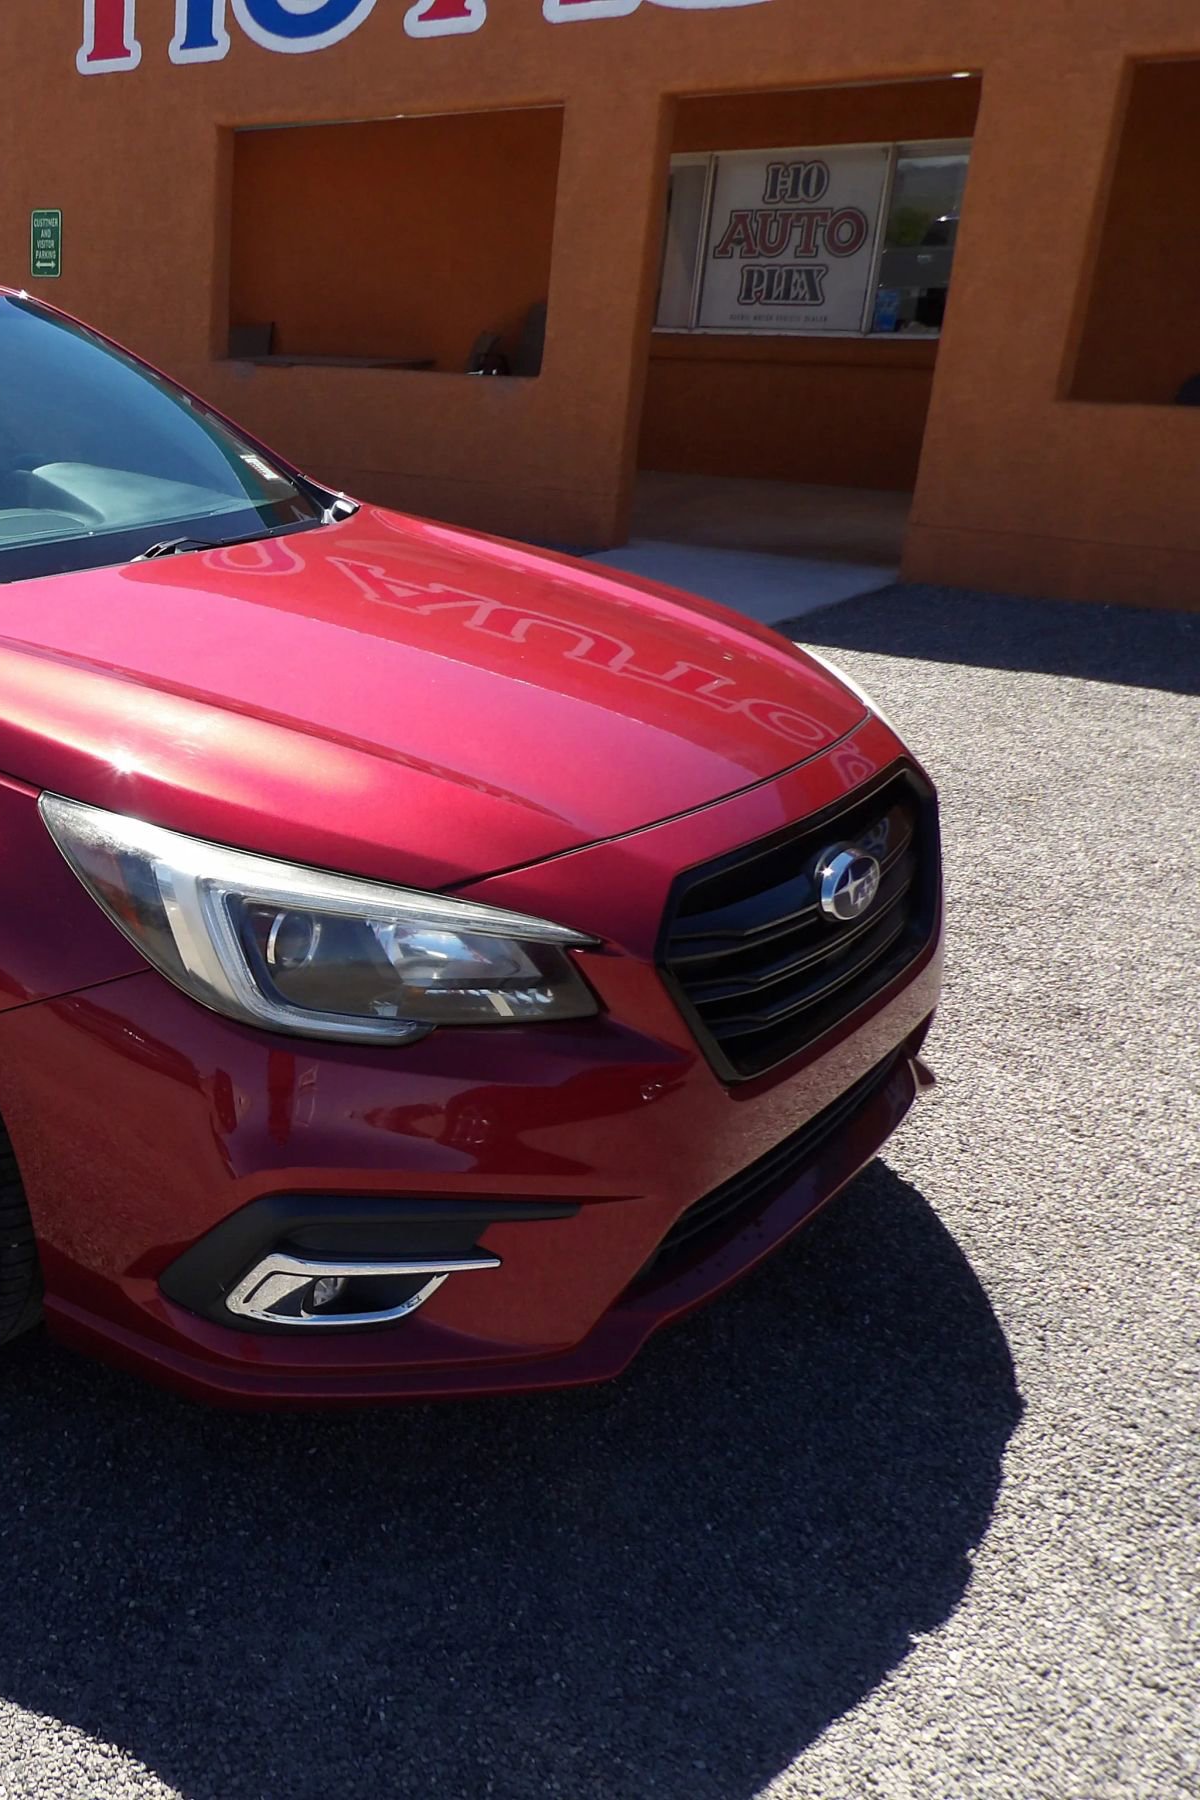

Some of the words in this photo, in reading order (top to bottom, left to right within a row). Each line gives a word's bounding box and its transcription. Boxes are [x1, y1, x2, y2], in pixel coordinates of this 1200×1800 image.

[41, 229, 51, 238] AND
[713, 207, 868, 258] AUTO
[37, 240, 55, 248] VISITOR
[36, 250, 56, 259] PARKING
[737, 264, 829, 306] PLEX
